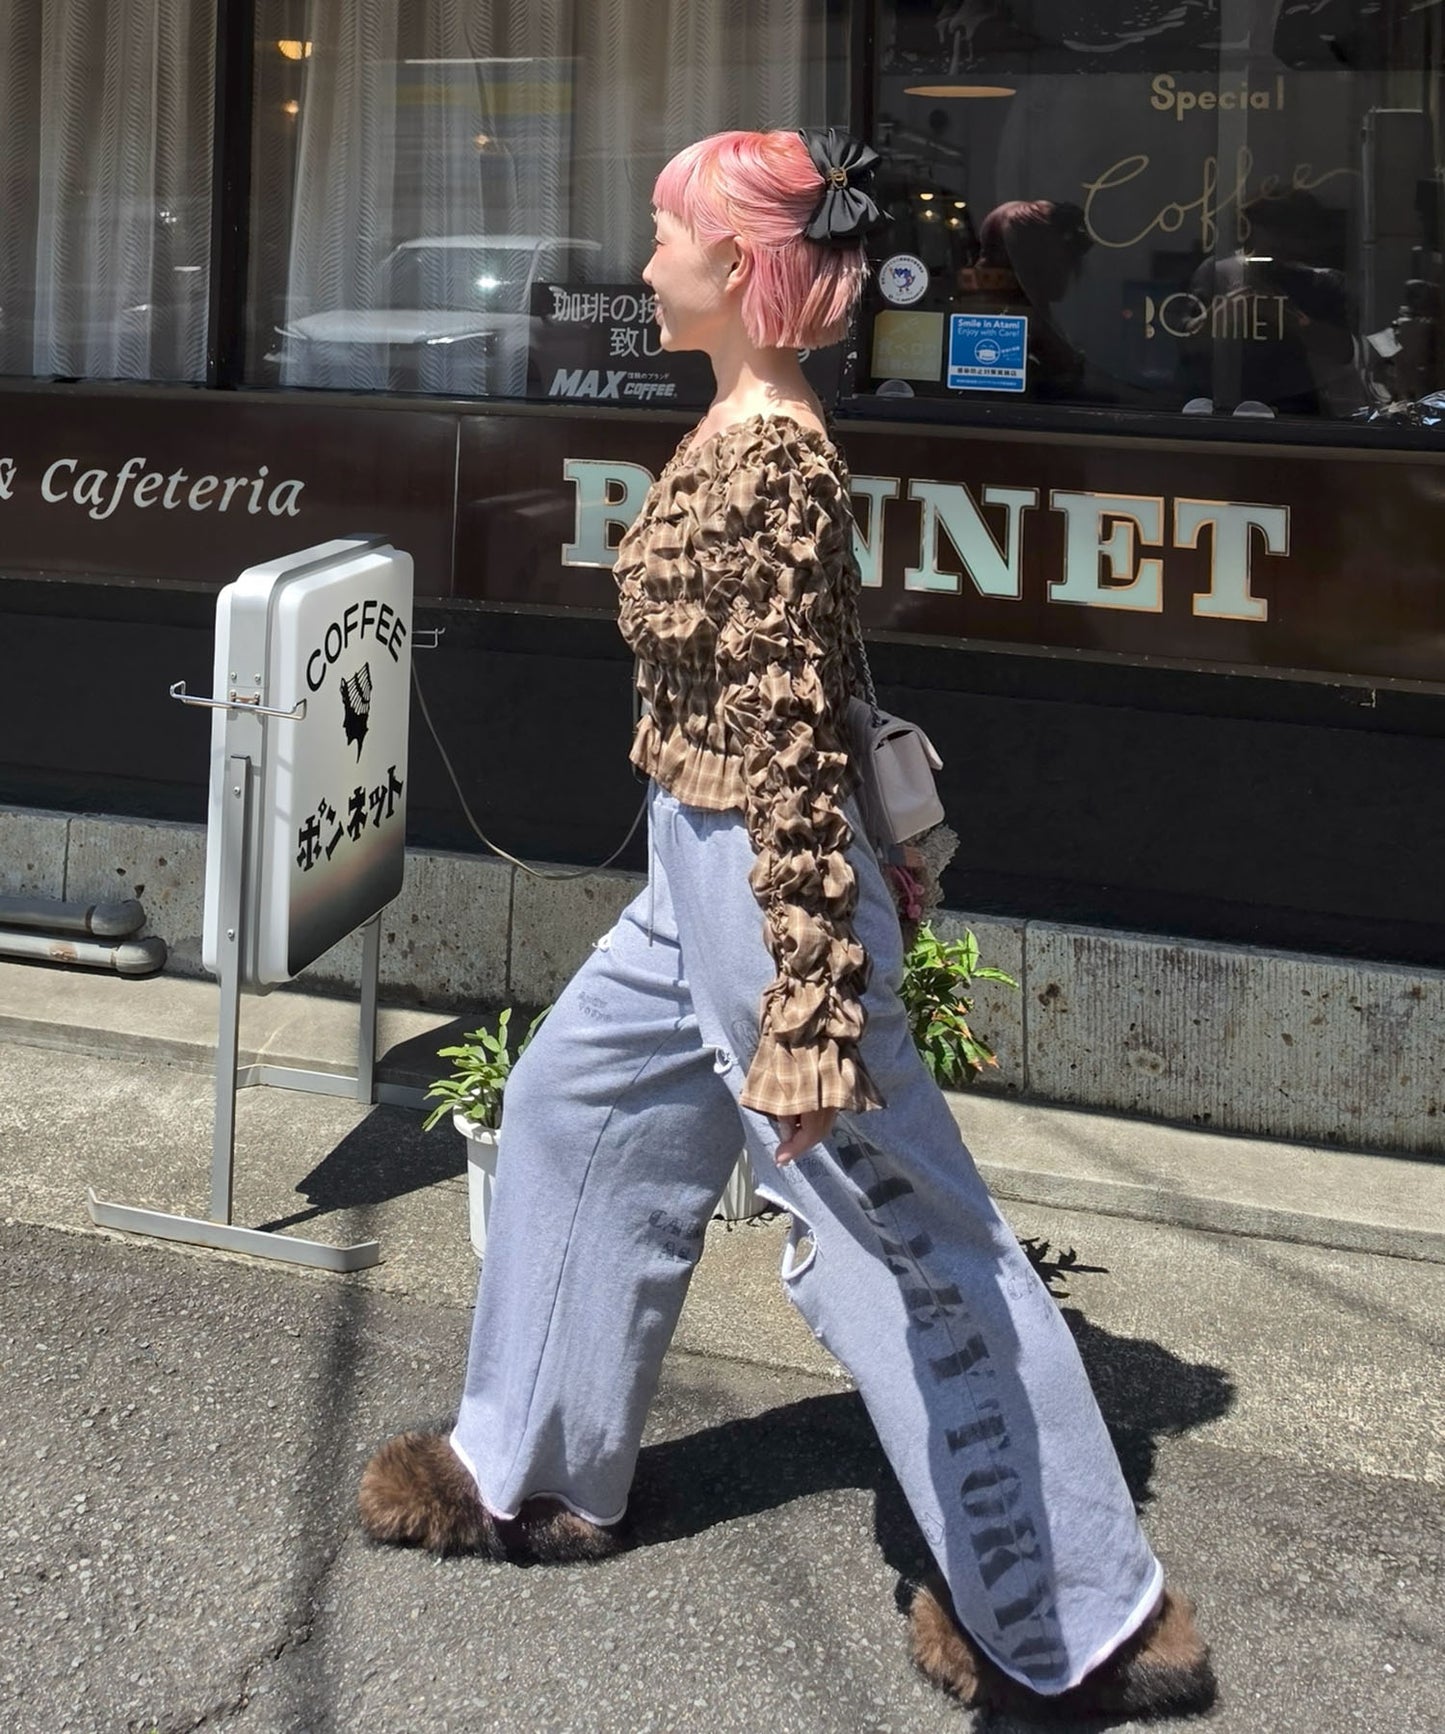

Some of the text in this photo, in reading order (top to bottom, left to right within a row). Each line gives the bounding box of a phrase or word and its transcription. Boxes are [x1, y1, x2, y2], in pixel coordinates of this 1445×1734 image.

[1151, 74, 1284, 121] Special
[1081, 145, 1361, 252] Coffee
[957, 328, 979, 337] Enjoy
[980, 328, 997, 337] with
[958, 318, 1020, 329] Smile in Atami
[548, 368, 627, 399] MAX
[623, 382, 676, 400] COFFEE
[41, 457, 305, 520] Cafeteria
[561, 458, 1292, 622] BNET
[306, 600, 406, 692] COFFEE
[945, 1398, 1071, 1681] TOKYO
